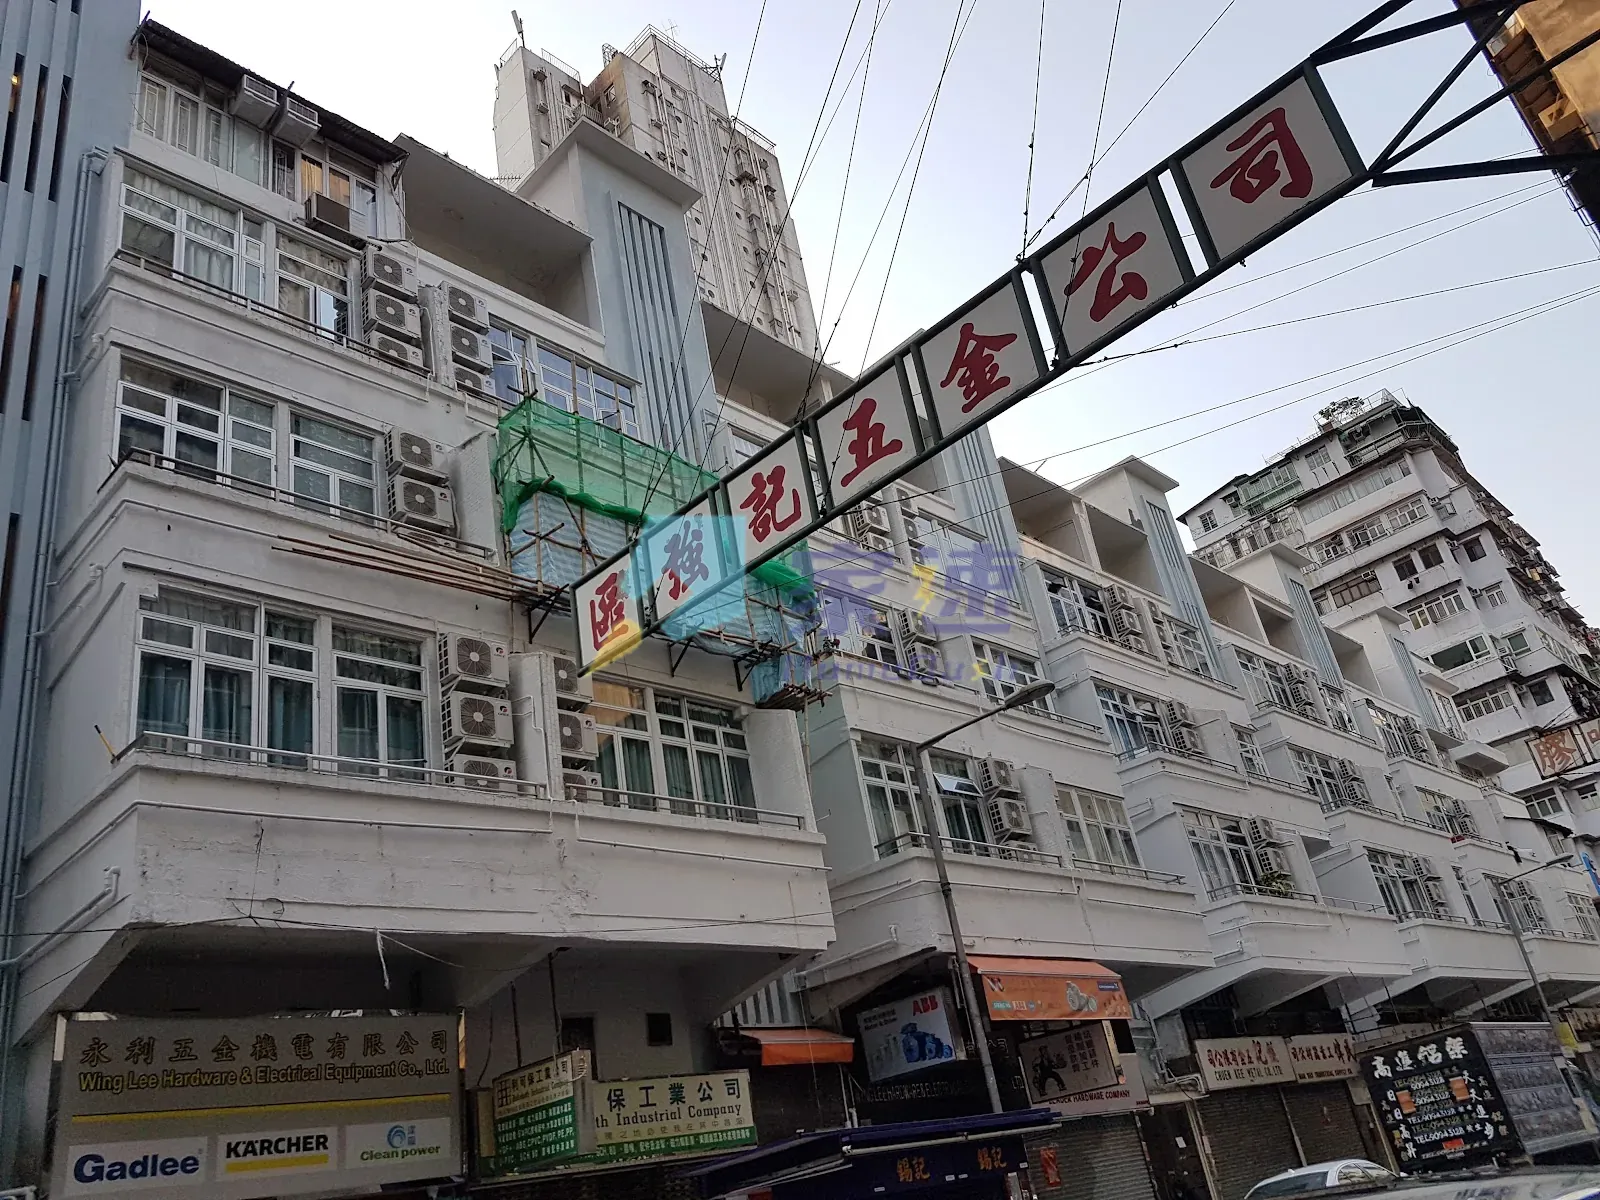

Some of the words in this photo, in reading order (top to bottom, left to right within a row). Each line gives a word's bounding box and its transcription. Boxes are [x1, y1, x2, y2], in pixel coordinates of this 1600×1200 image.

[913, 995, 938, 1016] ABB
[79, 1030, 449, 1067] 永利五金機電有限公司
[79, 1070, 123, 1094] Wing
[128, 1070, 158, 1090] Lee
[162, 1066, 237, 1088] Hardware
[240, 1067, 252, 1084] &
[256, 1063, 322, 1083] Electrical
[325, 1060, 396, 1083] Equipment
[398, 1060, 423, 1079] Co.,
[425, 1057, 450, 1076] Ltd.
[606, 1077, 742, 1113] 保工業公司
[1105, 1089, 1131, 1101] COMPANY
[616, 1107, 682, 1126] Industrial
[688, 1103, 742, 1119] Company
[226, 1134, 329, 1159] KÄRCHER
[360, 1149, 399, 1162] Clean
[401, 1145, 441, 1159] power
[73, 1153, 200, 1183] Gadlee
